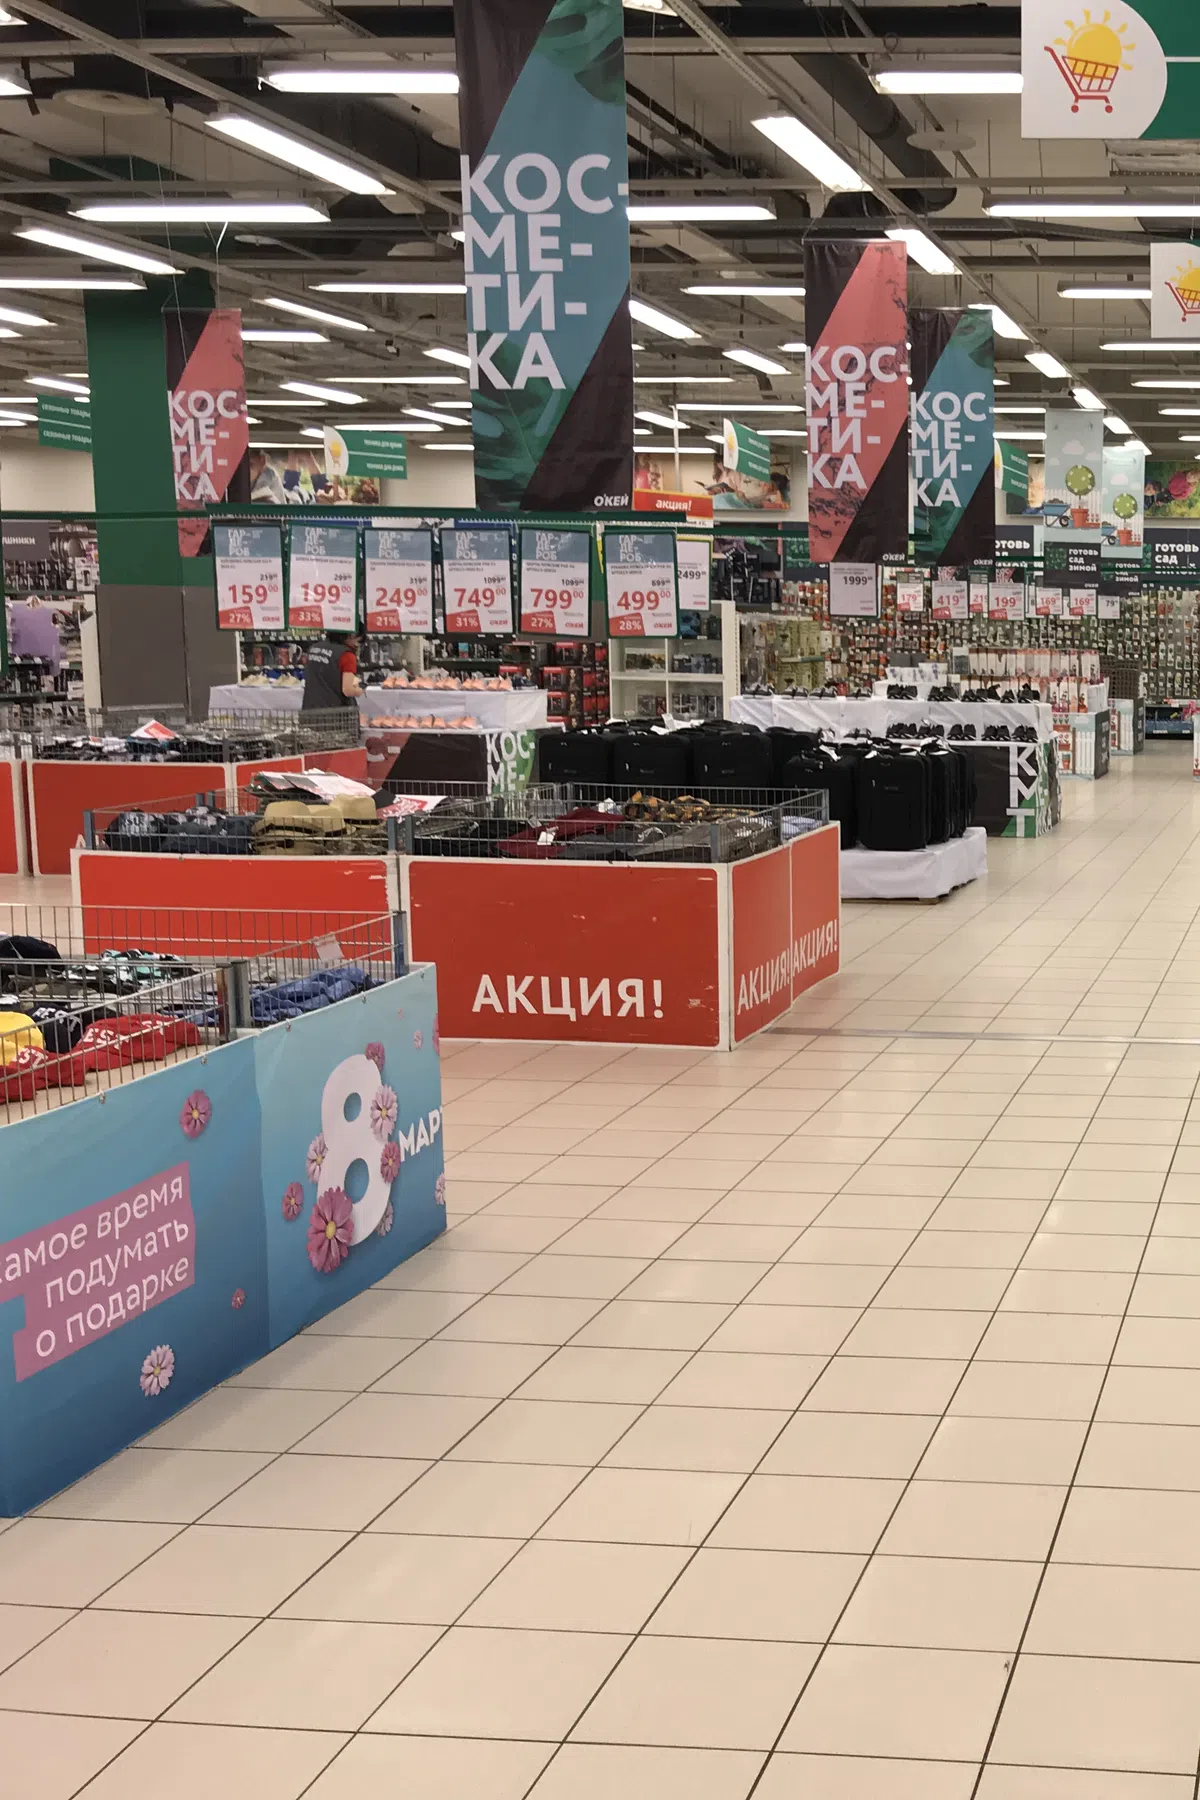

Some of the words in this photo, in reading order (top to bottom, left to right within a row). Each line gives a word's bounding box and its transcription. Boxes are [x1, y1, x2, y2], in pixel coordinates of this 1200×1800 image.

[460, 152, 629, 214] КОС-
[463, 213, 593, 273] МЕ-
[465, 273, 588, 332] ТИ-
[468, 332, 566, 390] КА
[805, 345, 908, 383] КОС-
[167, 390, 248, 419] КОС-
[805, 382, 885, 418] МЕ-
[910, 391, 994, 422] КОС-
[169, 418, 230, 446] МЕ-
[806, 417, 881, 454] ТИ-
[910, 420, 976, 450] МЕ-
[172, 445, 228, 473] ТИ-
[807, 453, 867, 490] КА
[911, 449, 973, 479] ТИ-
[174, 472, 220, 501] КА
[913, 478, 963, 507] КА
[655, 499, 693, 511] акция!
[995, 539, 1031, 550] отовь
[1068, 547, 1099, 556] готовь
[1155, 543, 1200, 553] готовь
[1068, 556, 1085, 564] сад
[1068, 563, 1097, 572] зимой
[1155, 554, 1178, 565] сад
[228, 584, 268, 604] 159
[300, 583, 340, 604] 199
[375, 587, 416, 608] 249
[453, 587, 496, 608] 749
[529, 588, 573, 610] 799
[616, 590, 660, 611] 499
[736, 947, 790, 1015] АКЦИЯ!
[792, 919, 838, 977] АКЦИЯ!
[471, 974, 665, 1022] АКЦИЯ!
[315, 1054, 392, 1248] 8
[97, 1175, 183, 1240] время
[45, 1219, 190, 1309] подумать
[36, 1329, 56, 1358] о
[66, 1256, 189, 1344] подарке
